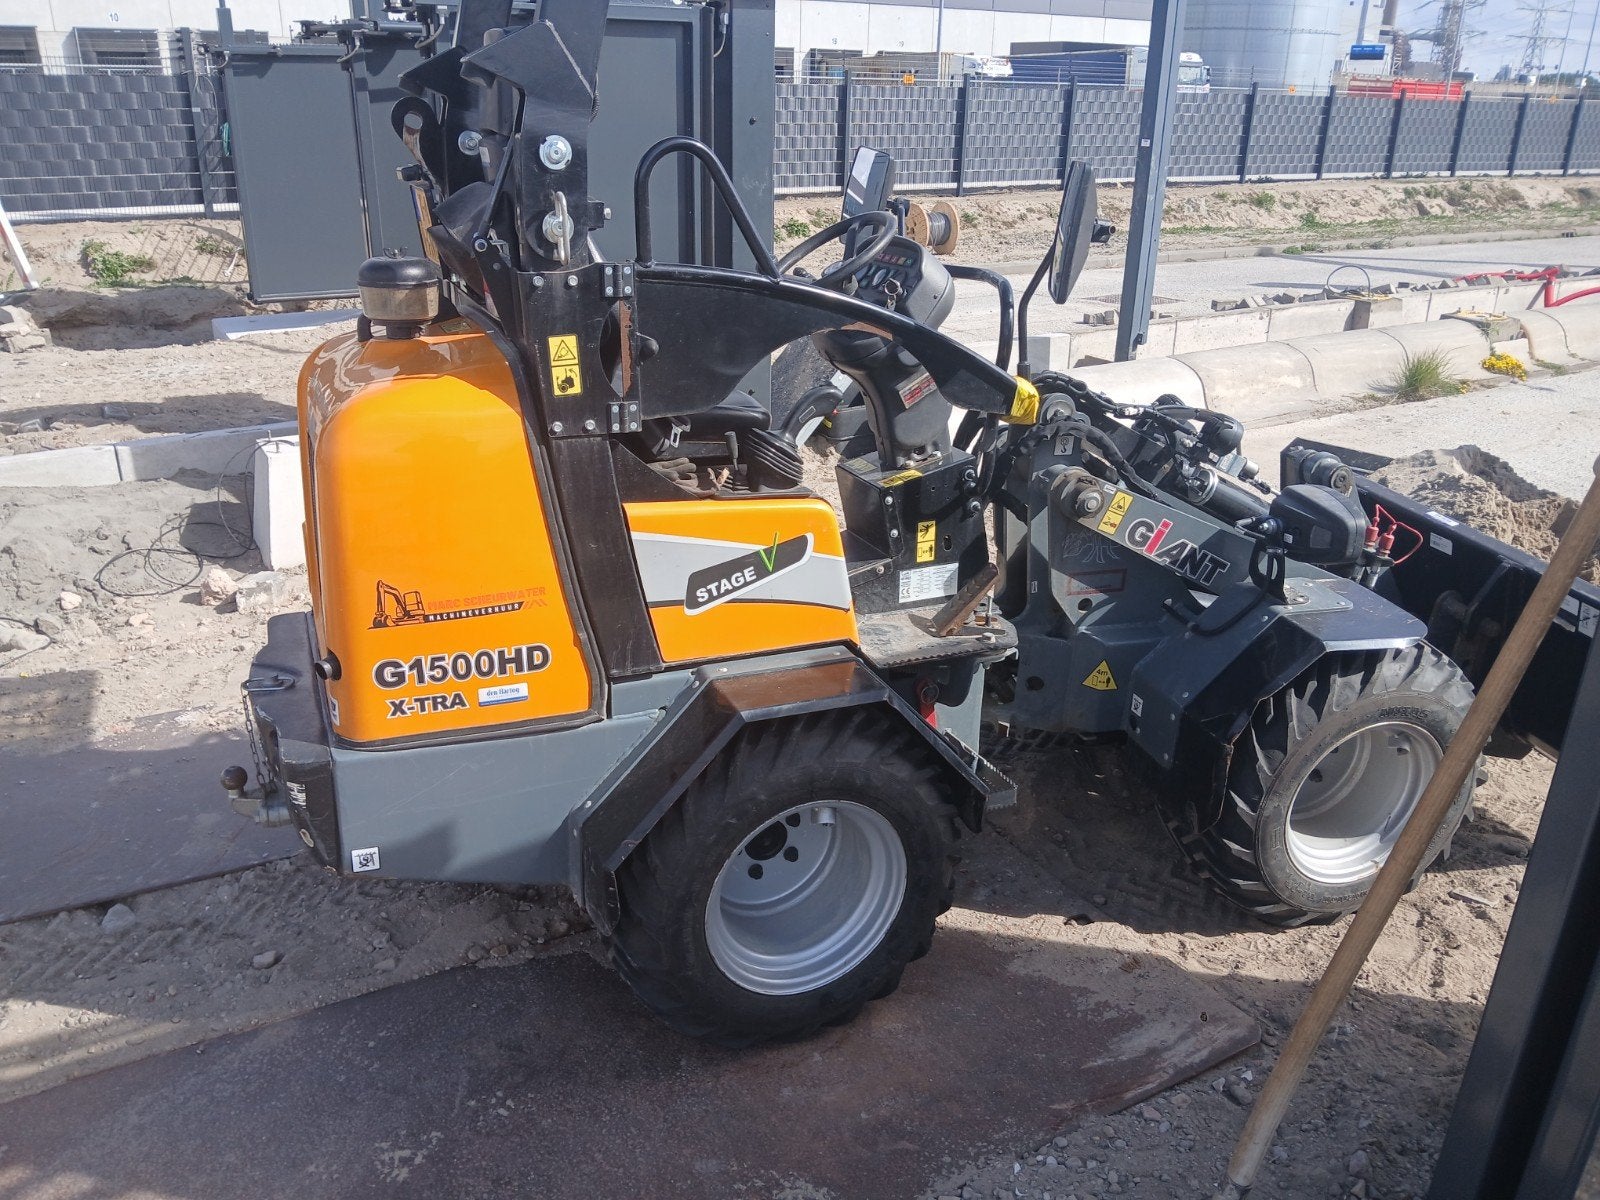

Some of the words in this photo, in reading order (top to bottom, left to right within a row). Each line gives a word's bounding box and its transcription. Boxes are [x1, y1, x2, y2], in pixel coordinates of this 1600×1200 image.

[696, 566, 757, 602] STAGE
[759, 531, 780, 573] V
[428, 599, 460, 611] MARC
[464, 587, 545, 606] SCHEURWATER
[429, 603, 520, 621] MACHINEVERHUUR
[372, 643, 551, 690] G1500HD
[1096, 668, 1109, 676] 4m
[387, 691, 470, 719] X-TRA
